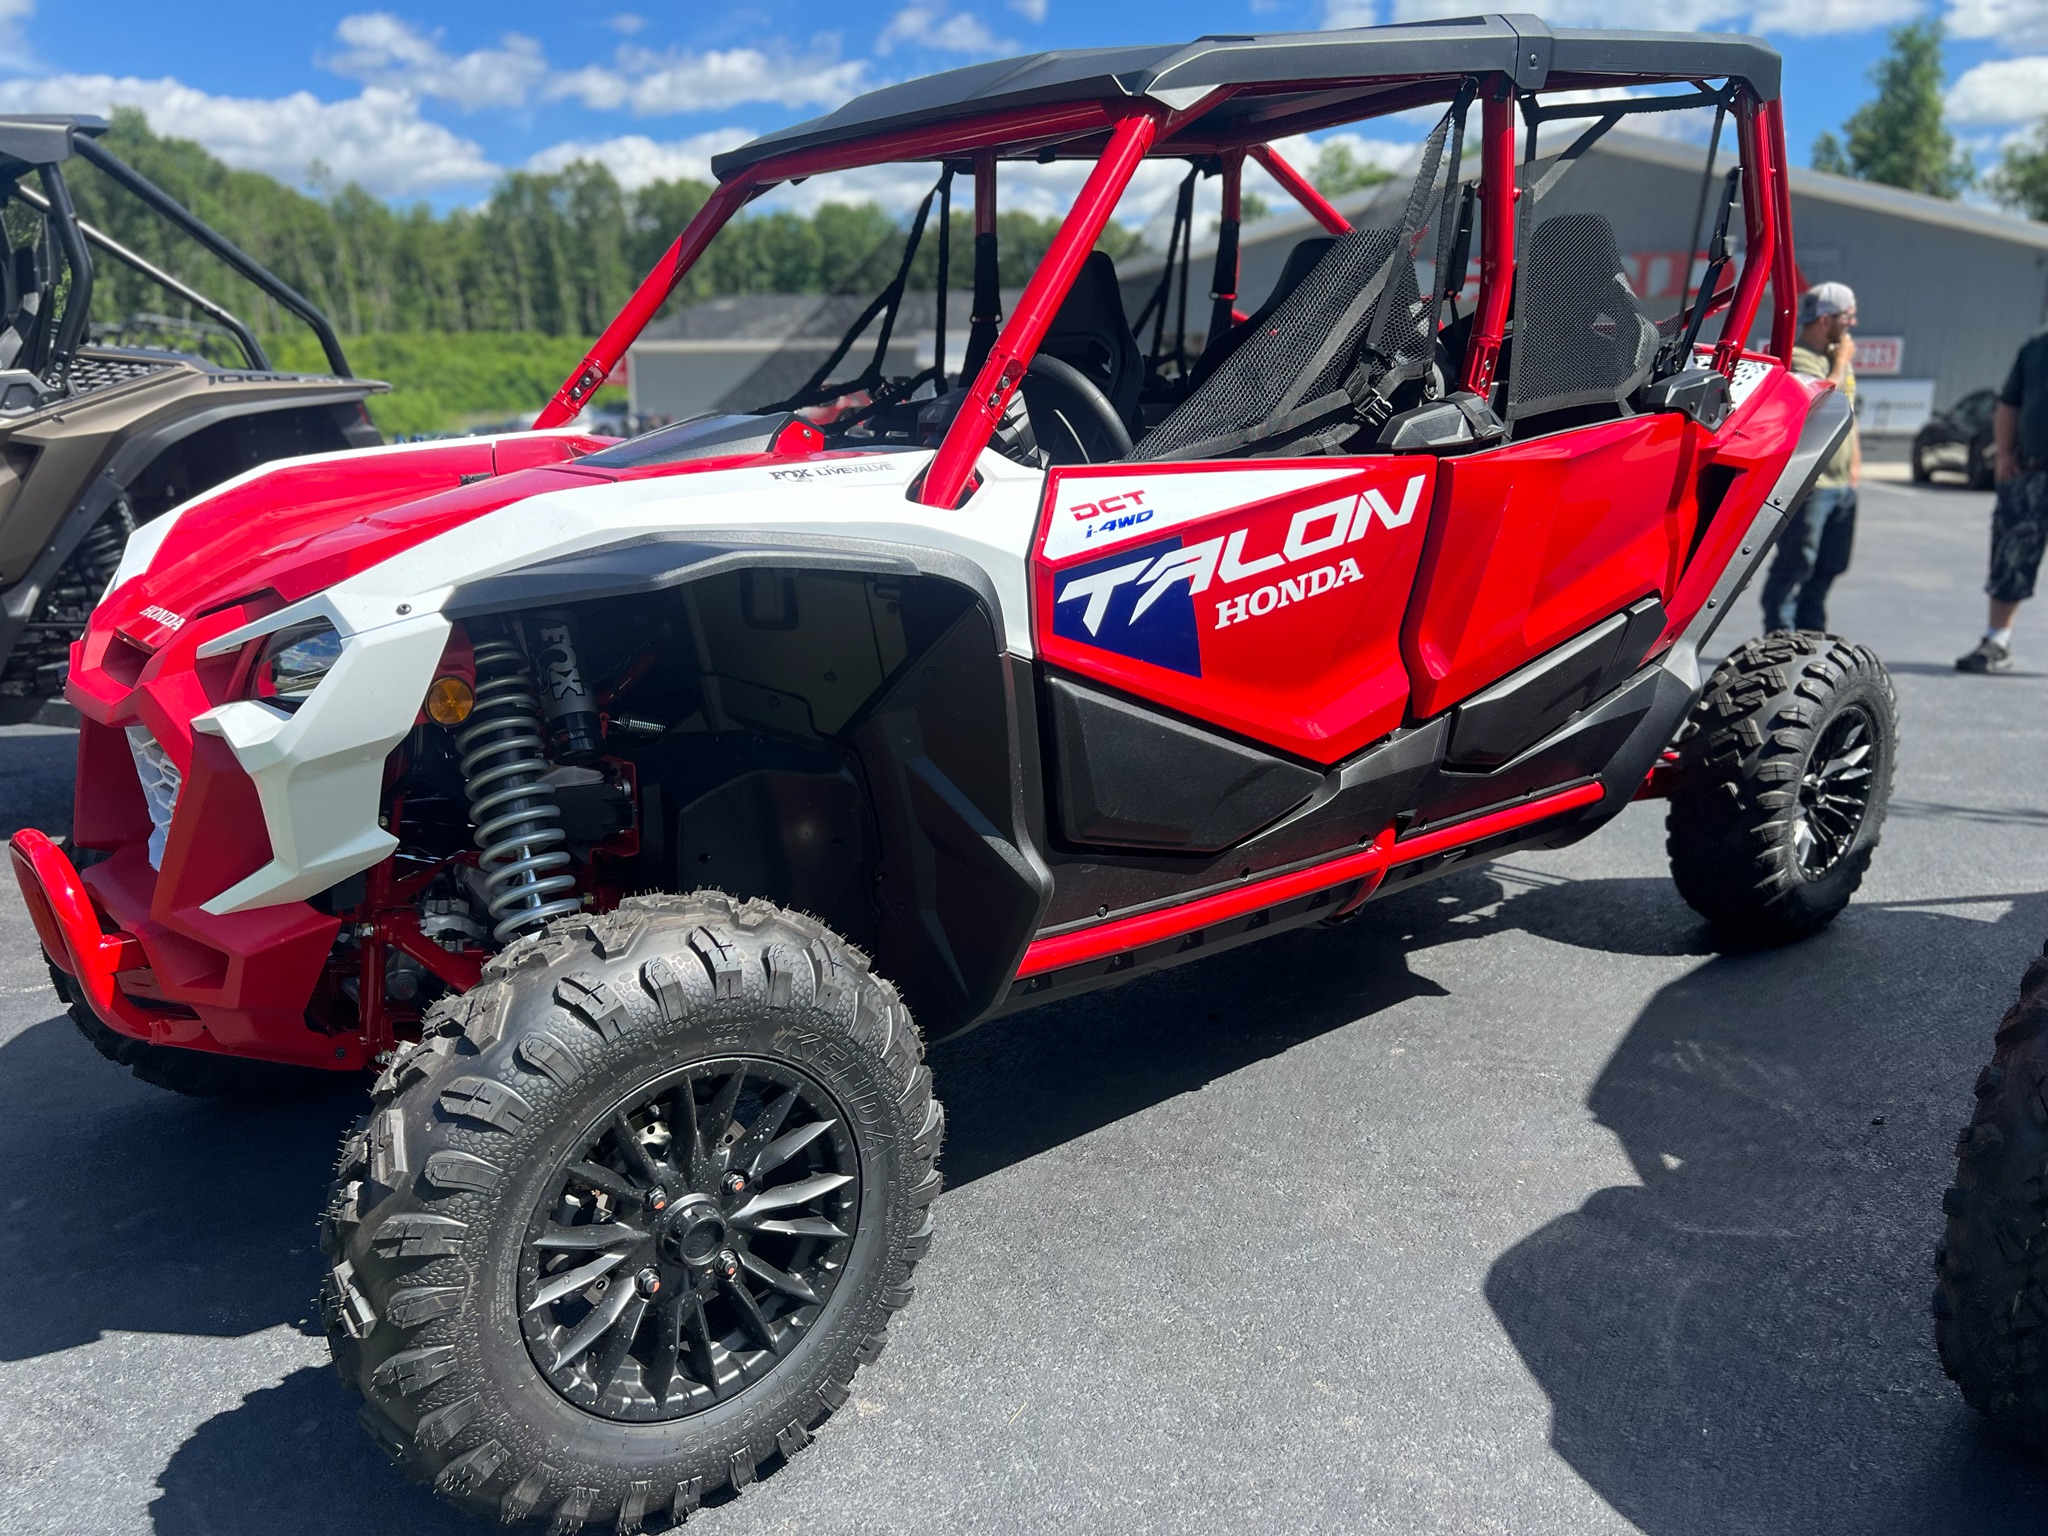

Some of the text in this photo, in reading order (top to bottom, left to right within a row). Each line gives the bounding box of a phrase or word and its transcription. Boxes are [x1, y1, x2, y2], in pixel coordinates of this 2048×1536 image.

[769, 468, 814, 483] FOX
[1069, 489, 1146, 522] DCT
[1086, 509, 1154, 538] i-4WD
[1057, 474, 1426, 637] TALON
[139, 604, 187, 632] HONDA
[1214, 557, 1364, 630] HONDA
[538, 623, 586, 702] FOX
[773, 1025, 895, 1163] KENDA
